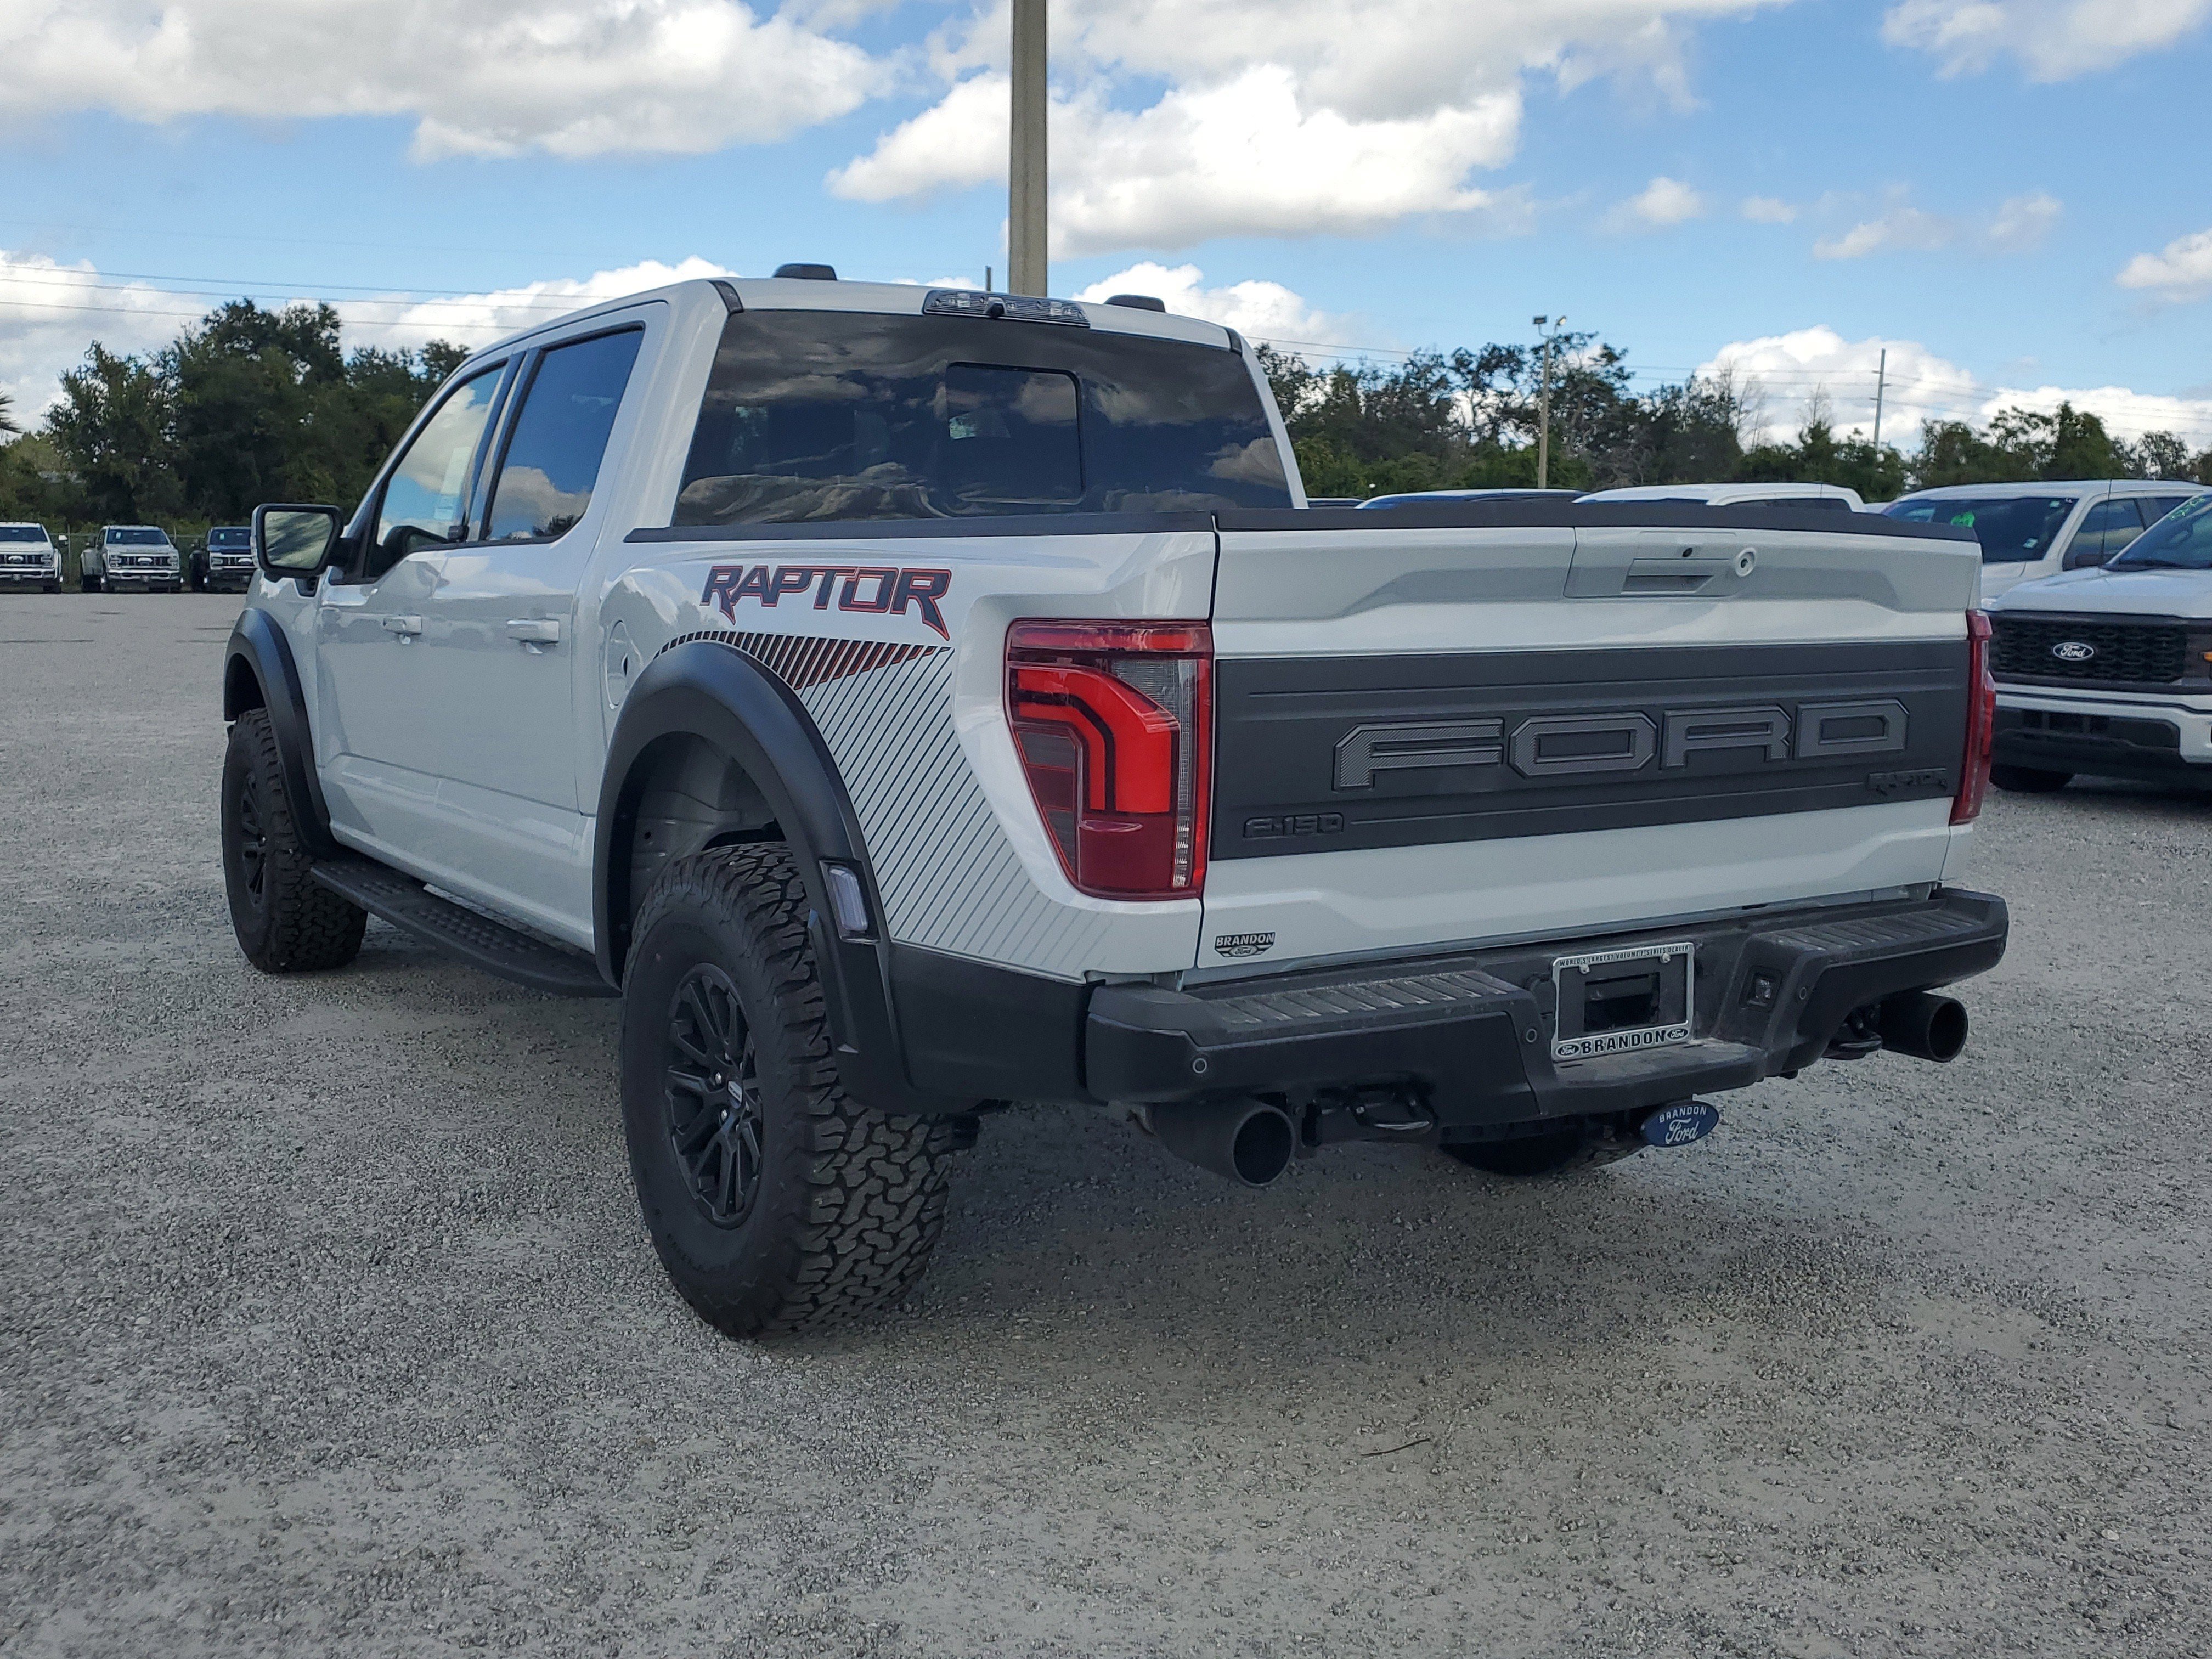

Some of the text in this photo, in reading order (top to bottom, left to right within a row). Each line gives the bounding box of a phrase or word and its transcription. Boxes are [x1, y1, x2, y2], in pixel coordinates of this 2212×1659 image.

[699, 565, 952, 642] RAPTOR
[1332, 698, 1910, 791] FORD
[1243, 812, 1344, 838] F-150
[1216, 933, 1275, 946] BRANDON
[1588, 954, 1614, 963] LARGEST
[1668, 945, 1689, 953] DEALER
[1581, 1030, 1667, 1054] BRANDON
[1659, 1106, 1707, 1123] BRANDON
[1665, 1118, 1700, 1144] Ford
